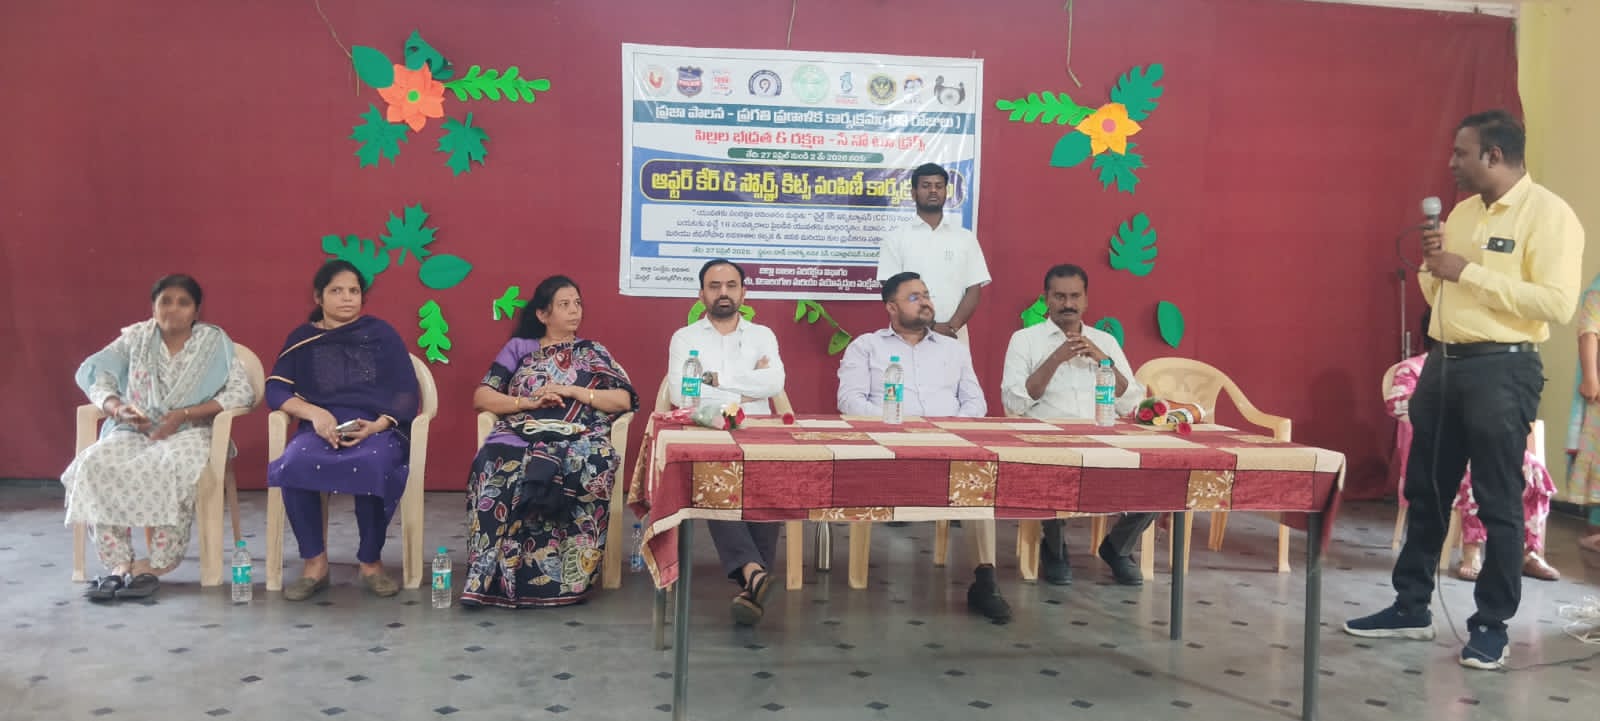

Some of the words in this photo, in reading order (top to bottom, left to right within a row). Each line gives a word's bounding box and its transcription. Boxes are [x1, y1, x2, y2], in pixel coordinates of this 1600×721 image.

[688, 106, 724, 119] పాలన
[737, 108, 771, 122] ప్రగతి
[695, 129, 729, 145] పిల్లల
[733, 130, 772, 145] భద్రత
[776, 131, 786, 143] &
[791, 132, 824, 148] రక్షణ
[761, 151, 771, 159] 27
[652, 169, 693, 199] ఆఫ్టర్
[696, 168, 720, 191] కేర్
[723, 172, 736, 192] &
[815, 172, 864, 196] పంపిణీ
